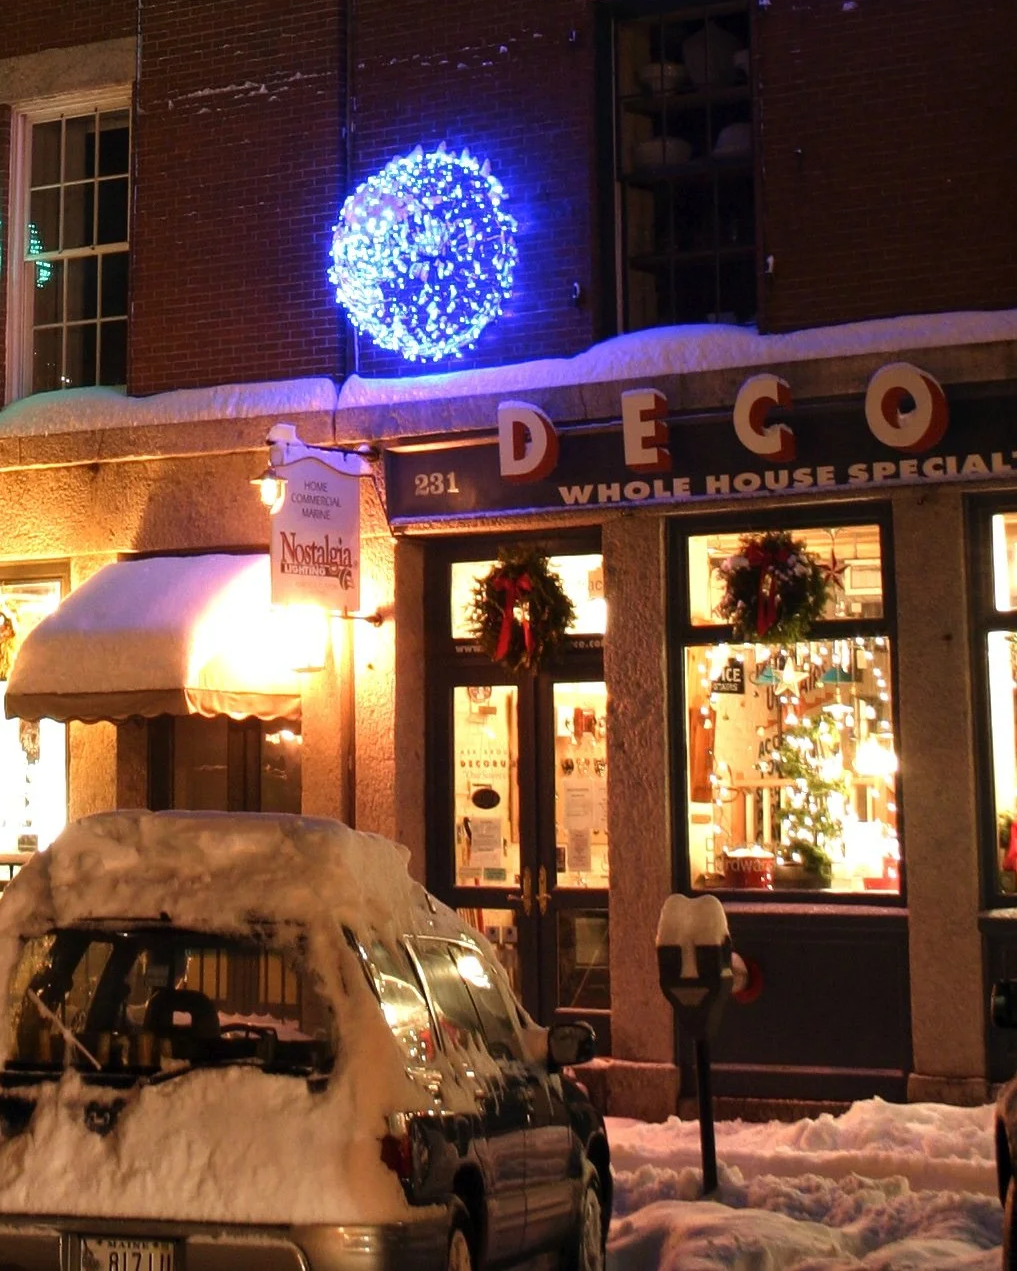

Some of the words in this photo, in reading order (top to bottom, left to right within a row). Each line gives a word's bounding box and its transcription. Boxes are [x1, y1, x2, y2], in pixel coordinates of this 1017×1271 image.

[498, 361, 948, 484] DECO
[415, 471, 460, 496] 231
[558, 477, 691, 505] WHOLE
[705, 465, 835, 495] HOUSE
[847, 450, 1017, 484] SPECIAL
[304, 481, 328, 493] HOME
[291, 493, 342, 507] COMMERCIAL
[302, 508, 330, 520] MARINE
[280, 531, 352, 568] Nostalgia
[284, 562, 326, 577] LIGHTING
[108, 1240, 149, 1249] MAINE
